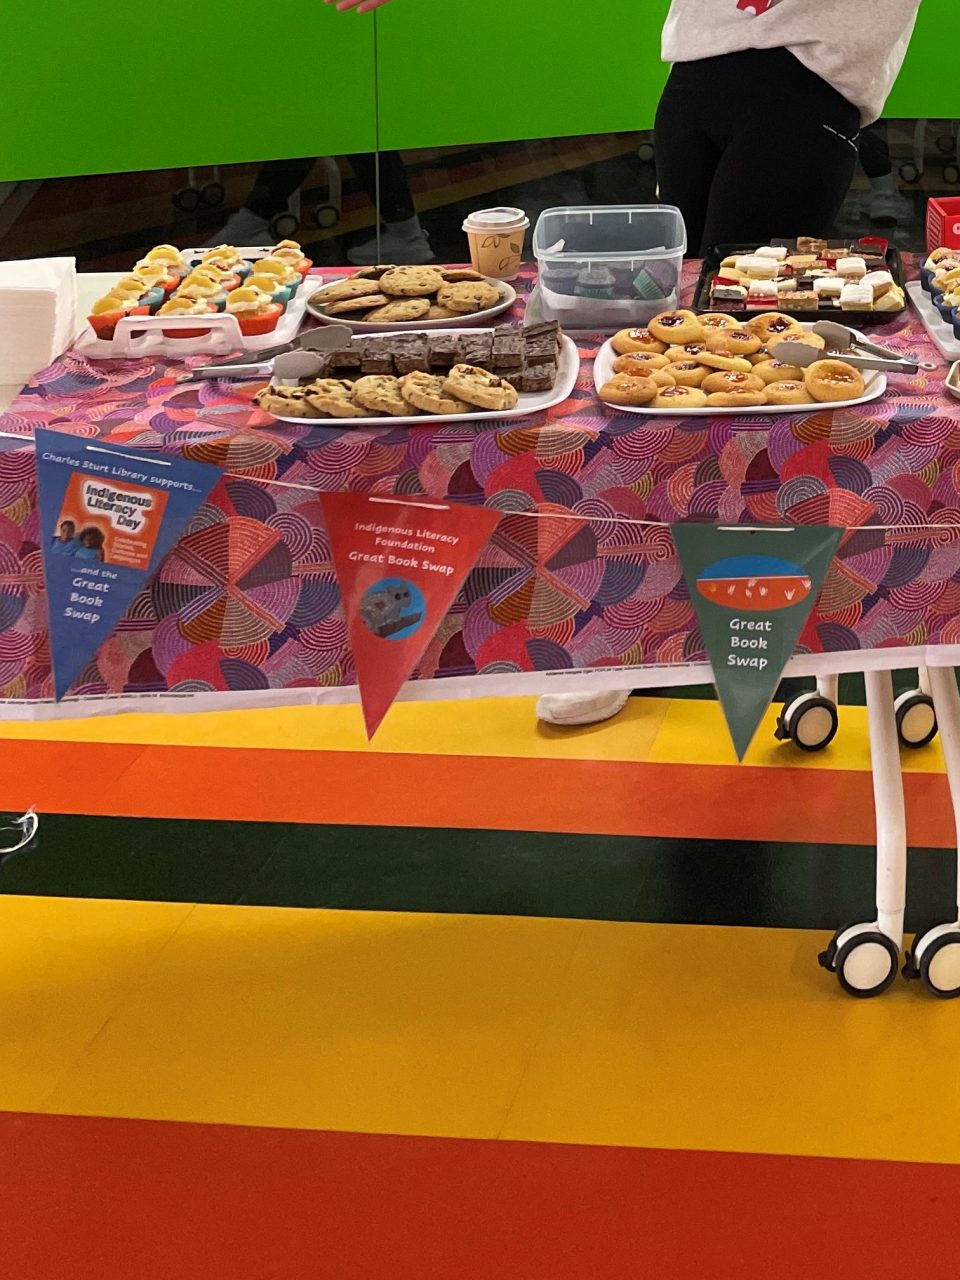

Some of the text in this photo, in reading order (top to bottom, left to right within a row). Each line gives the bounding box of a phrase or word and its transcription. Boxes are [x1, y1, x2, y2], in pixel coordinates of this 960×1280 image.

[41, 451, 80, 468] Charles
[82, 460, 109, 474] Sturt
[111, 465, 147, 483] Library
[85, 484, 153, 508] Indigenous
[87, 496, 138, 518] Literacy
[116, 516, 142, 530] Day
[354, 522, 459, 546] Indigenous Literacy
[375, 537, 436, 554] Foundation
[349, 551, 455, 577] Great Book Swap
[102, 570, 118, 580] the
[72, 577, 111, 594] Great
[70, 592, 104, 608] Book
[64, 607, 101, 624] Swap
[729, 618, 773, 632] Great
[731, 636, 768, 650] Book
[727, 654, 769, 671] Swap
